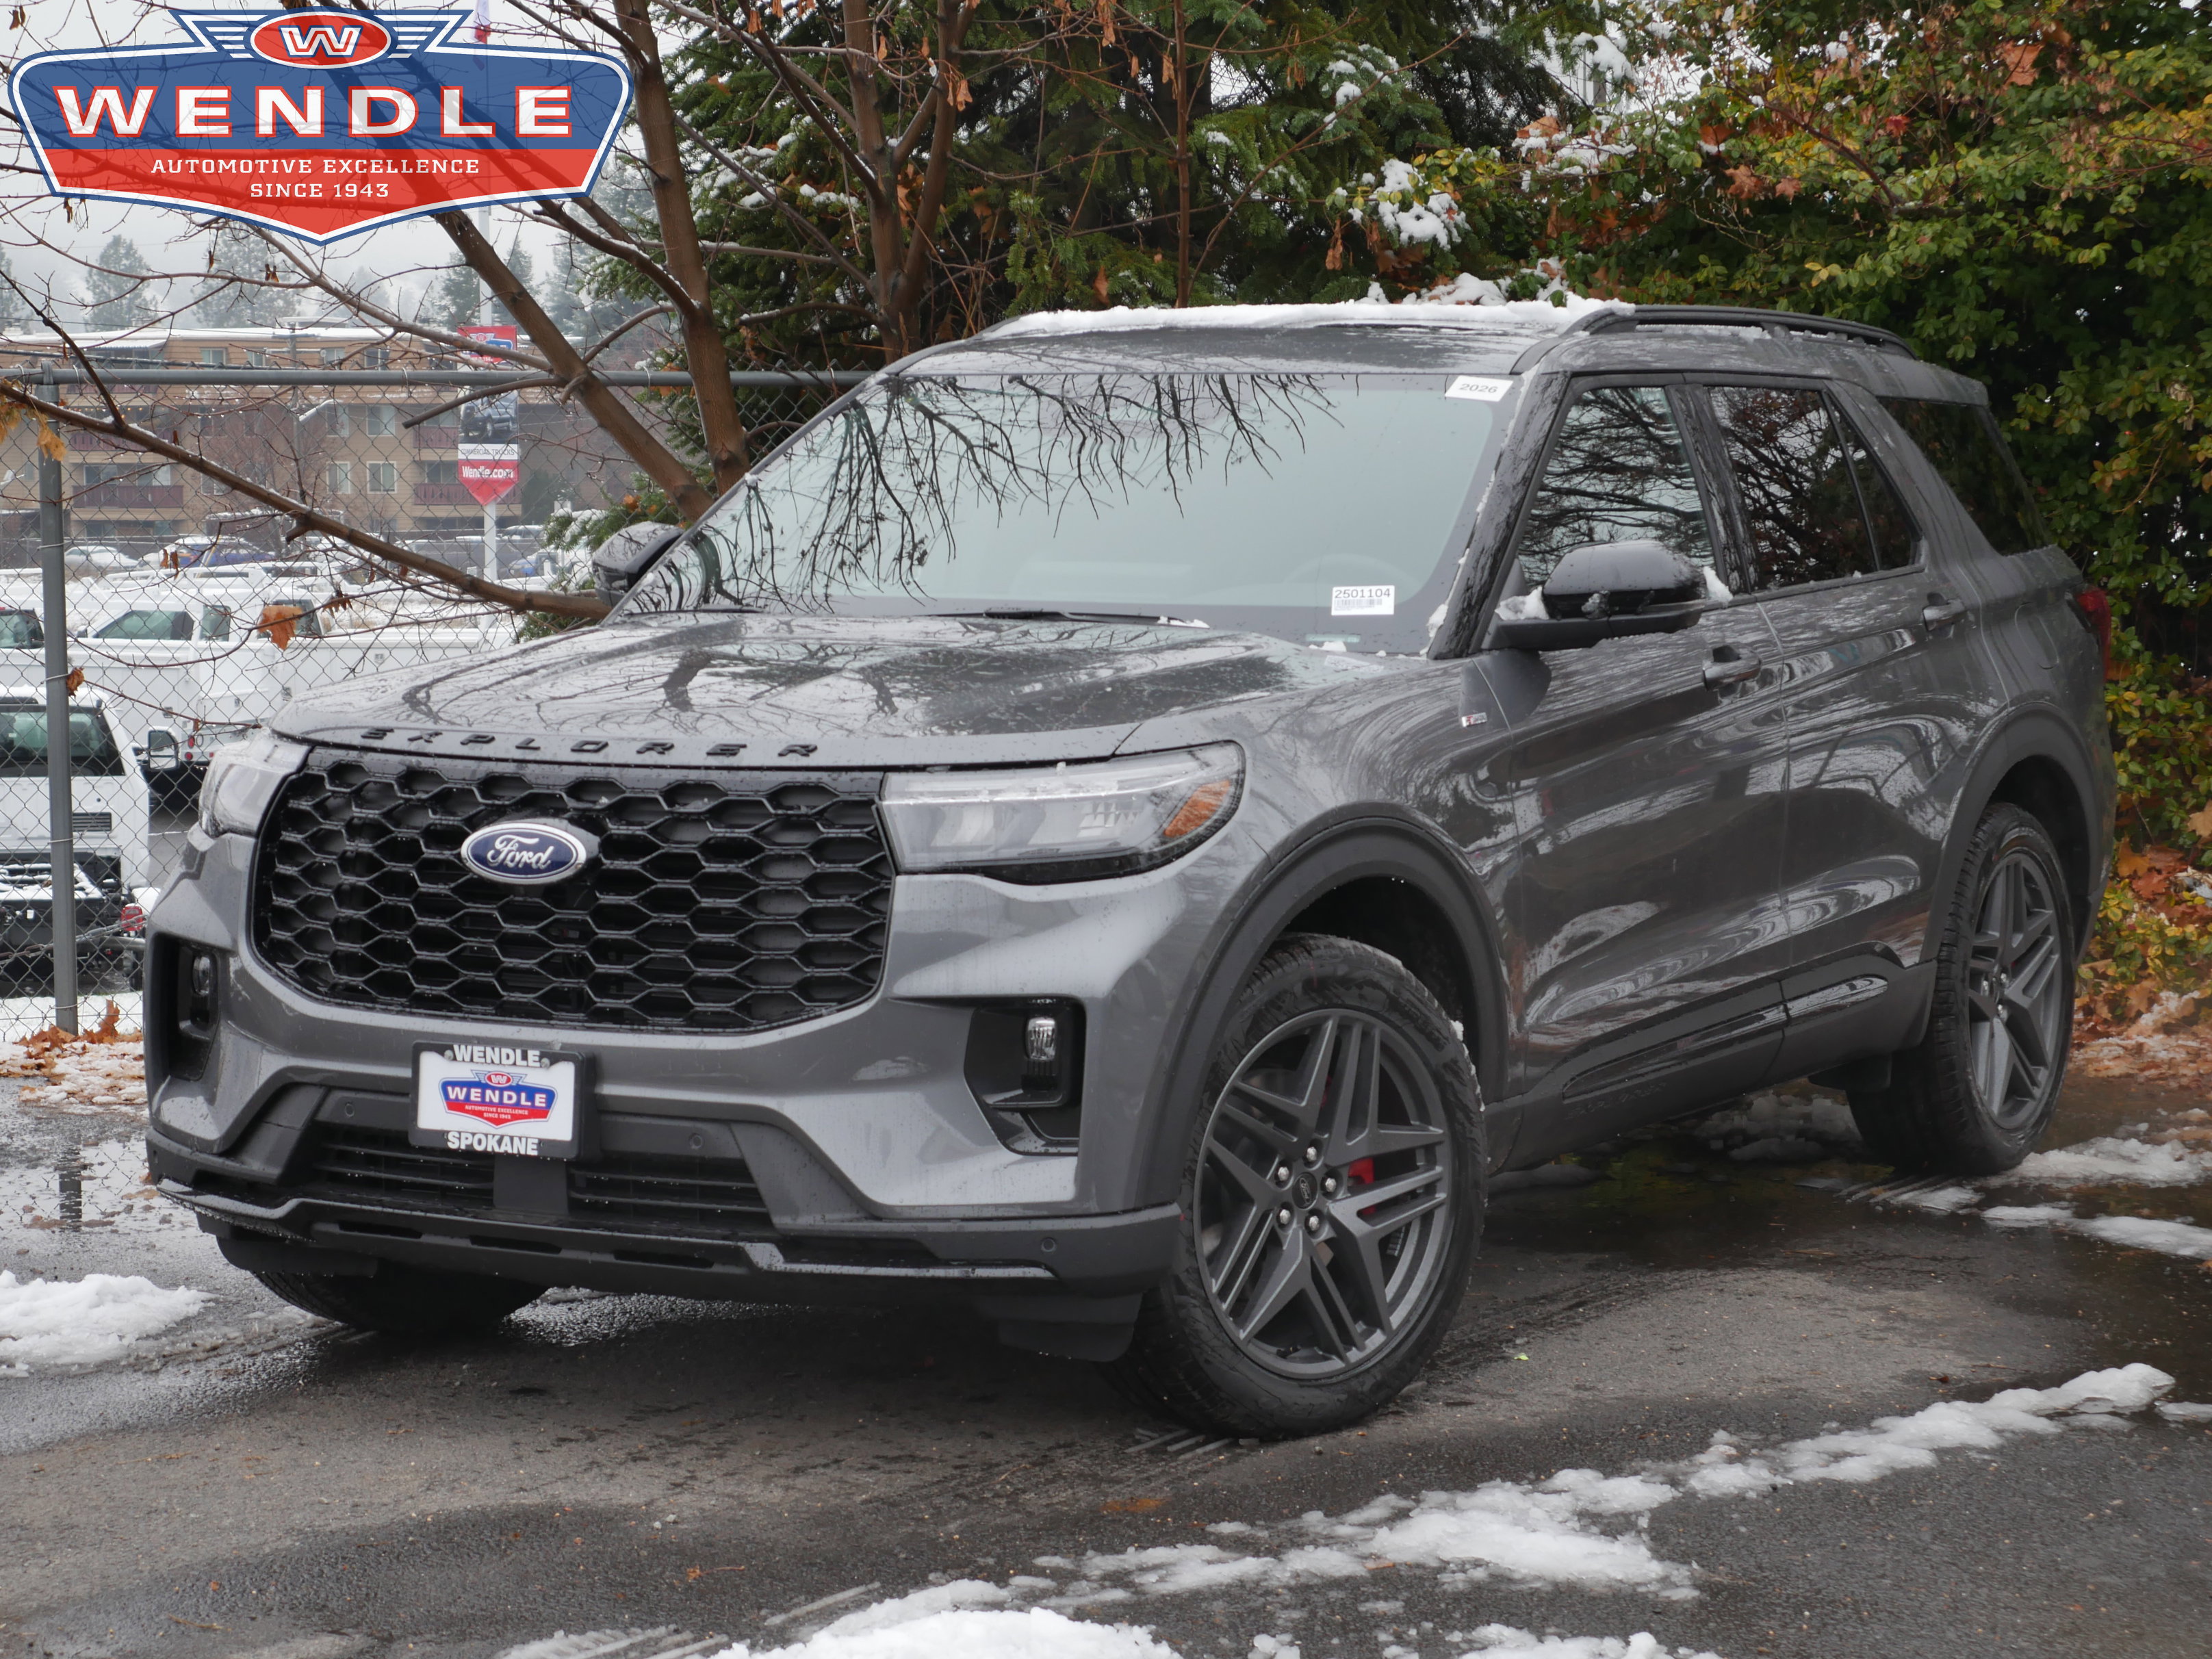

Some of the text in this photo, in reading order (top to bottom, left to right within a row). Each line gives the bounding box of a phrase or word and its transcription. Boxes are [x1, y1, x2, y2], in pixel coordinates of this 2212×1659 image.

[1459, 383, 1498, 394] 2026
[462, 465, 514, 478] Wendle.com
[1335, 588, 1391, 598] 2501104
[487, 834, 551, 871] Ford
[453, 1044, 541, 1068] WENDLE
[447, 1086, 547, 1107] WENDLE
[465, 1105, 496, 1113] AUTOMOTIVE
[447, 1131, 539, 1155] SPOKANE
